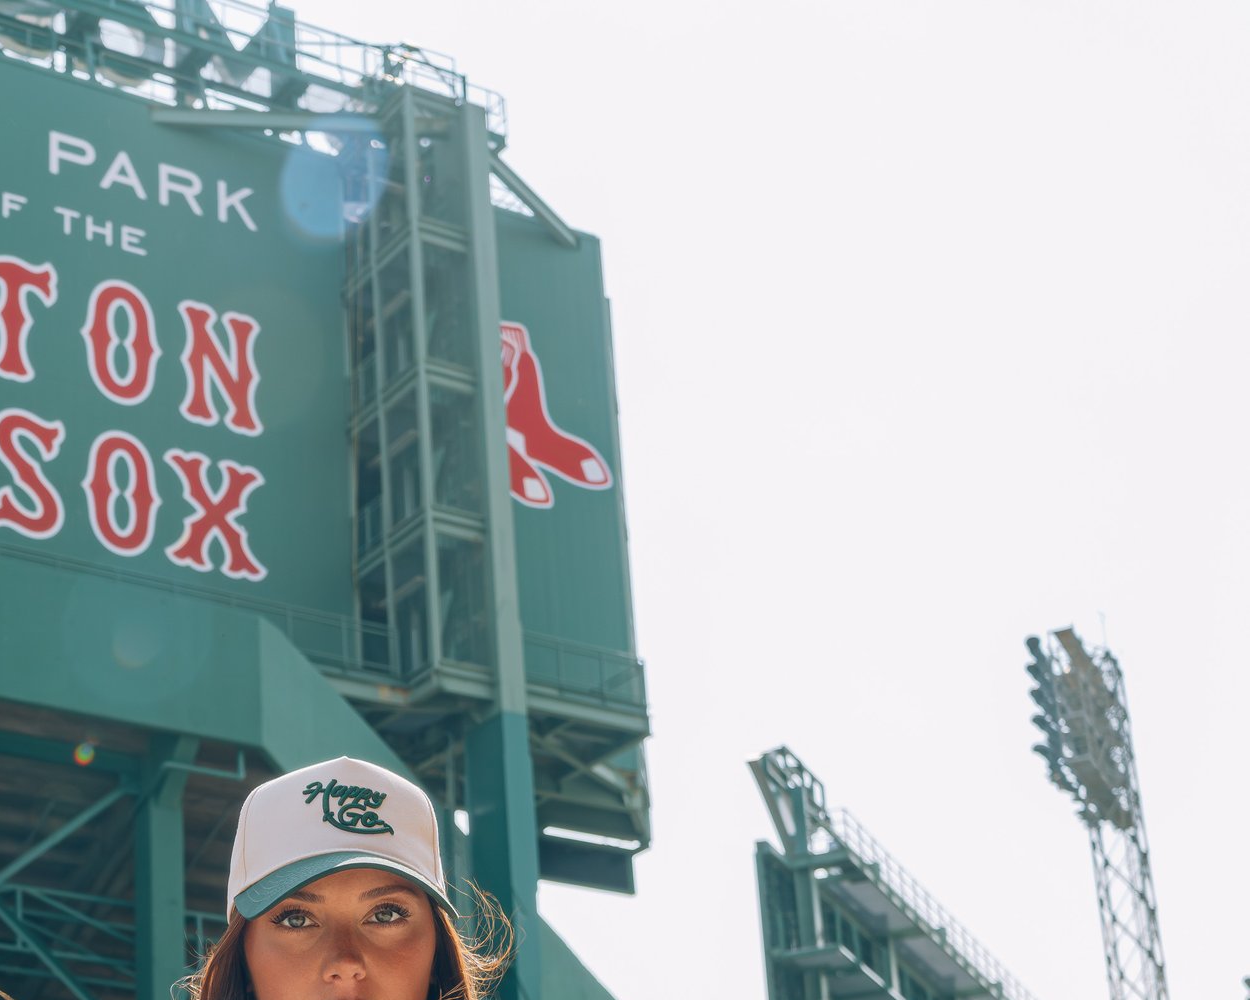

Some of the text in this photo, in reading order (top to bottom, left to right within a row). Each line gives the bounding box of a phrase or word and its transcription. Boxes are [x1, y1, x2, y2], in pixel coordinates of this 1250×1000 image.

[48, 131, 257, 231] PARK
[55, 207, 147, 256] THE
[302, 779, 388, 815] Happy
[338, 804, 386, 828] Go
